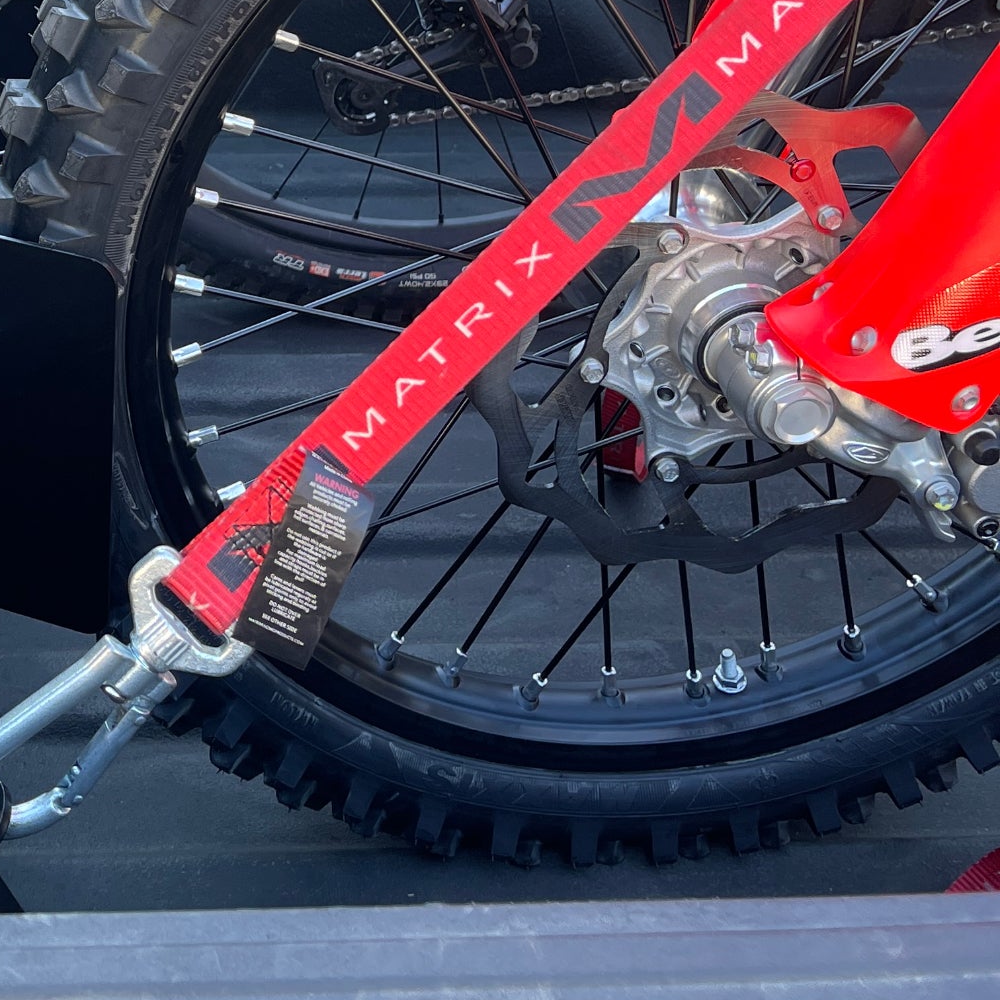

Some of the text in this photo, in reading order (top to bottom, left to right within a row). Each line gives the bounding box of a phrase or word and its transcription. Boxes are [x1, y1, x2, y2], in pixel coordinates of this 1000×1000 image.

[342, 240, 552, 451] MATRIX
[891, 317, 1000, 372] Be
[313, 472, 360, 499] WARNING
